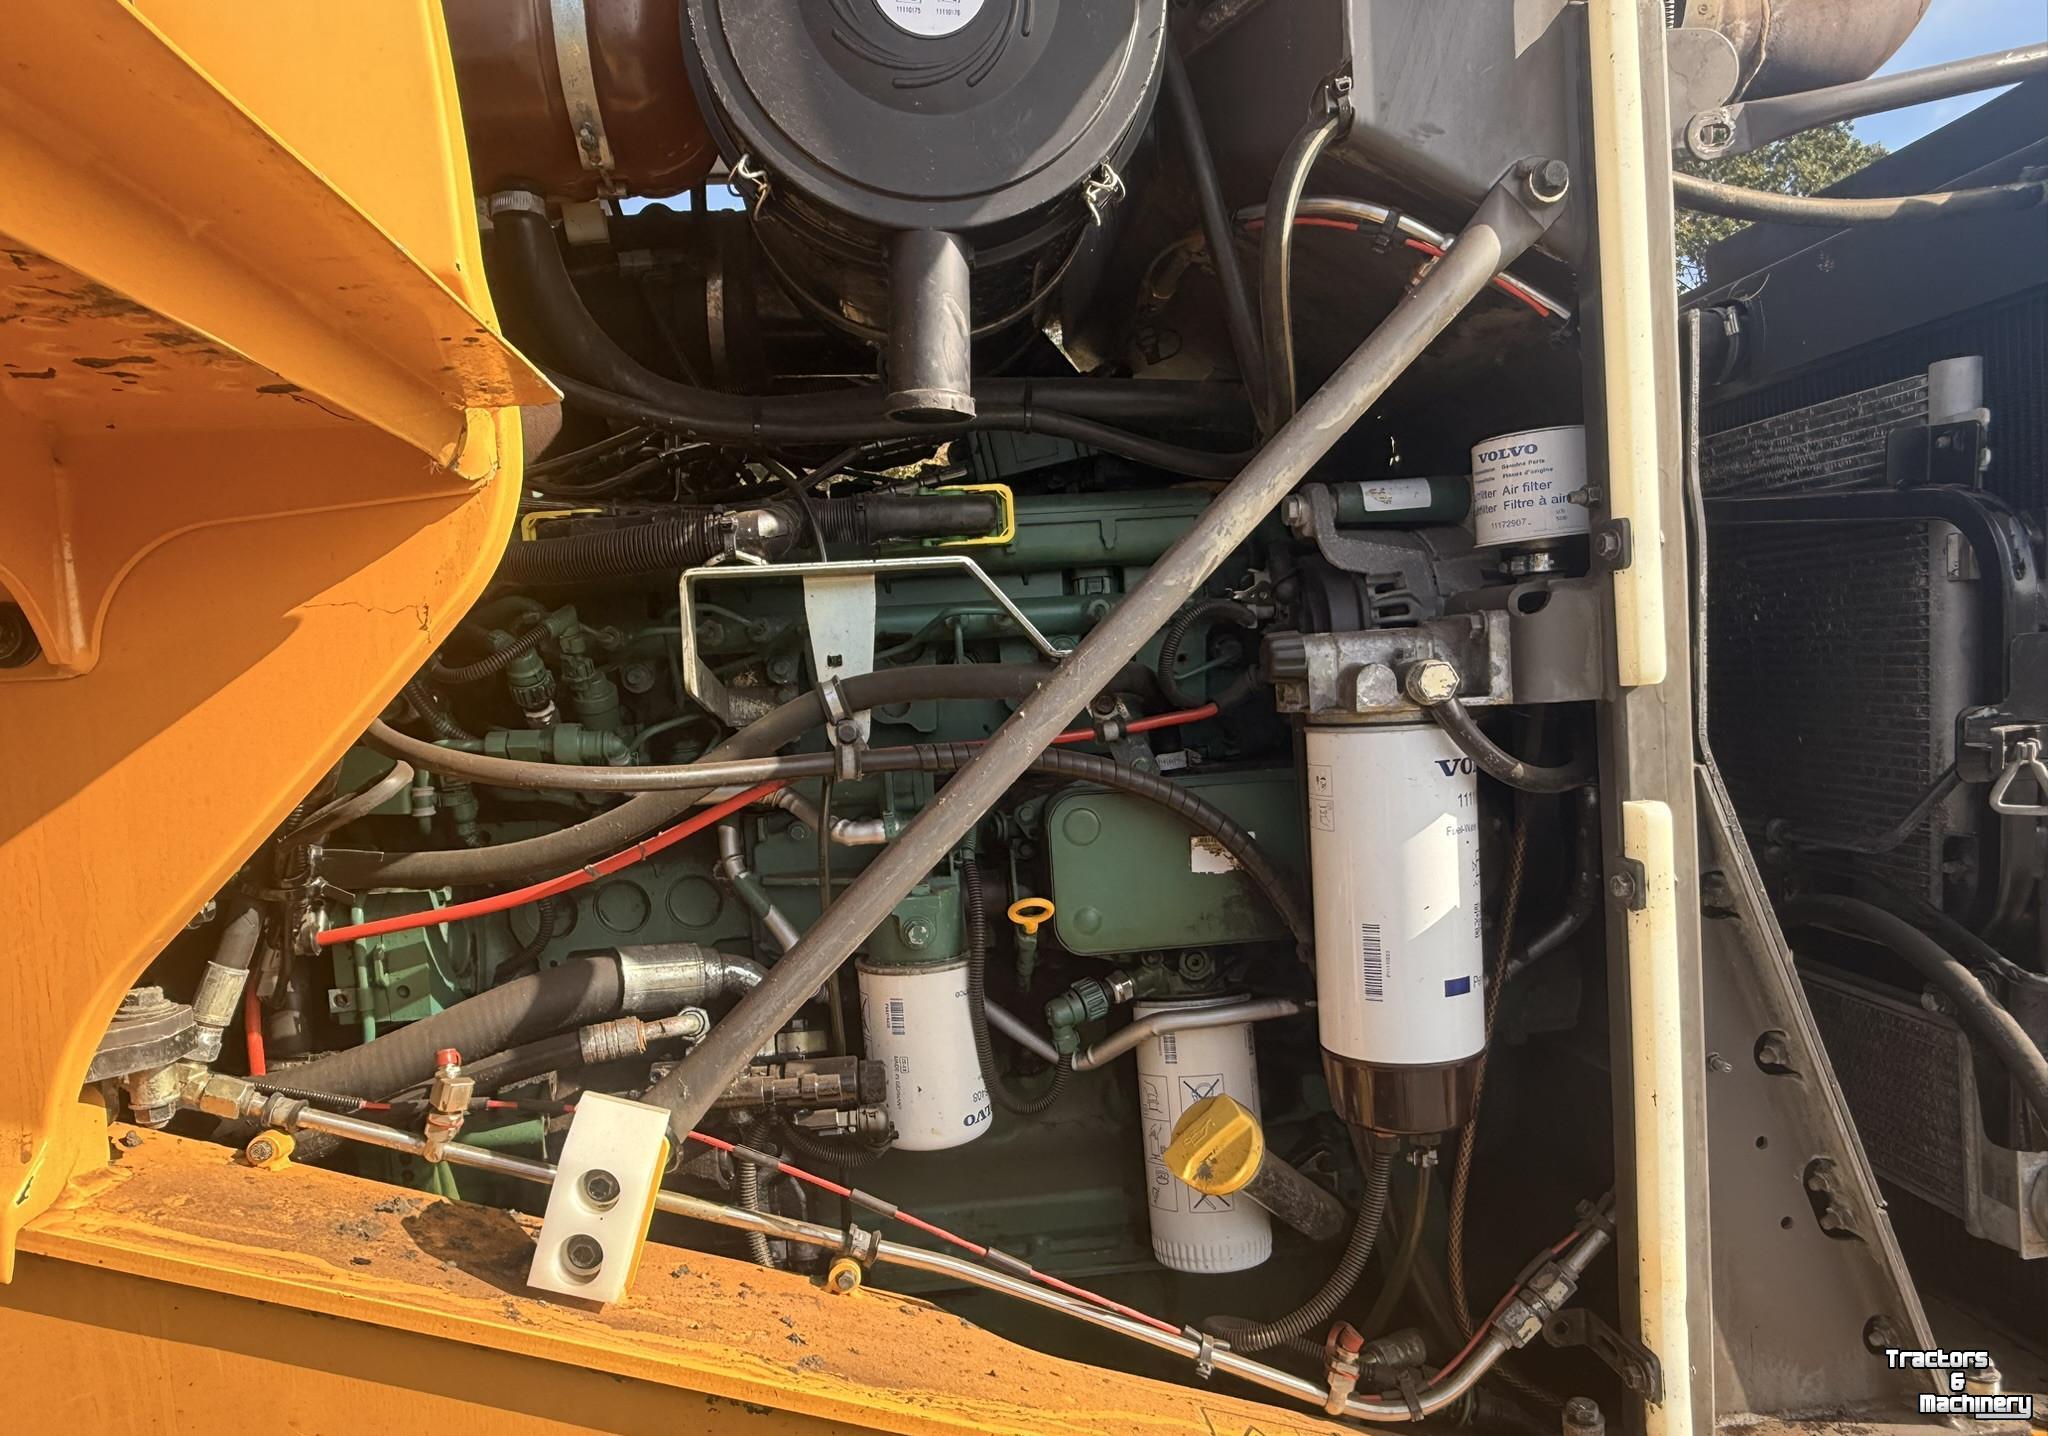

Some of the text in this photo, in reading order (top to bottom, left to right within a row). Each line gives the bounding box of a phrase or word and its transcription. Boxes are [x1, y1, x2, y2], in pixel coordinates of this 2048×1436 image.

[1478, 443, 1538, 463] VOLVO
[1502, 485, 1518, 496] Air
[1522, 480, 1553, 492] filter
[1503, 498, 1534, 510] Filtre
[1538, 495, 1547, 506] à
